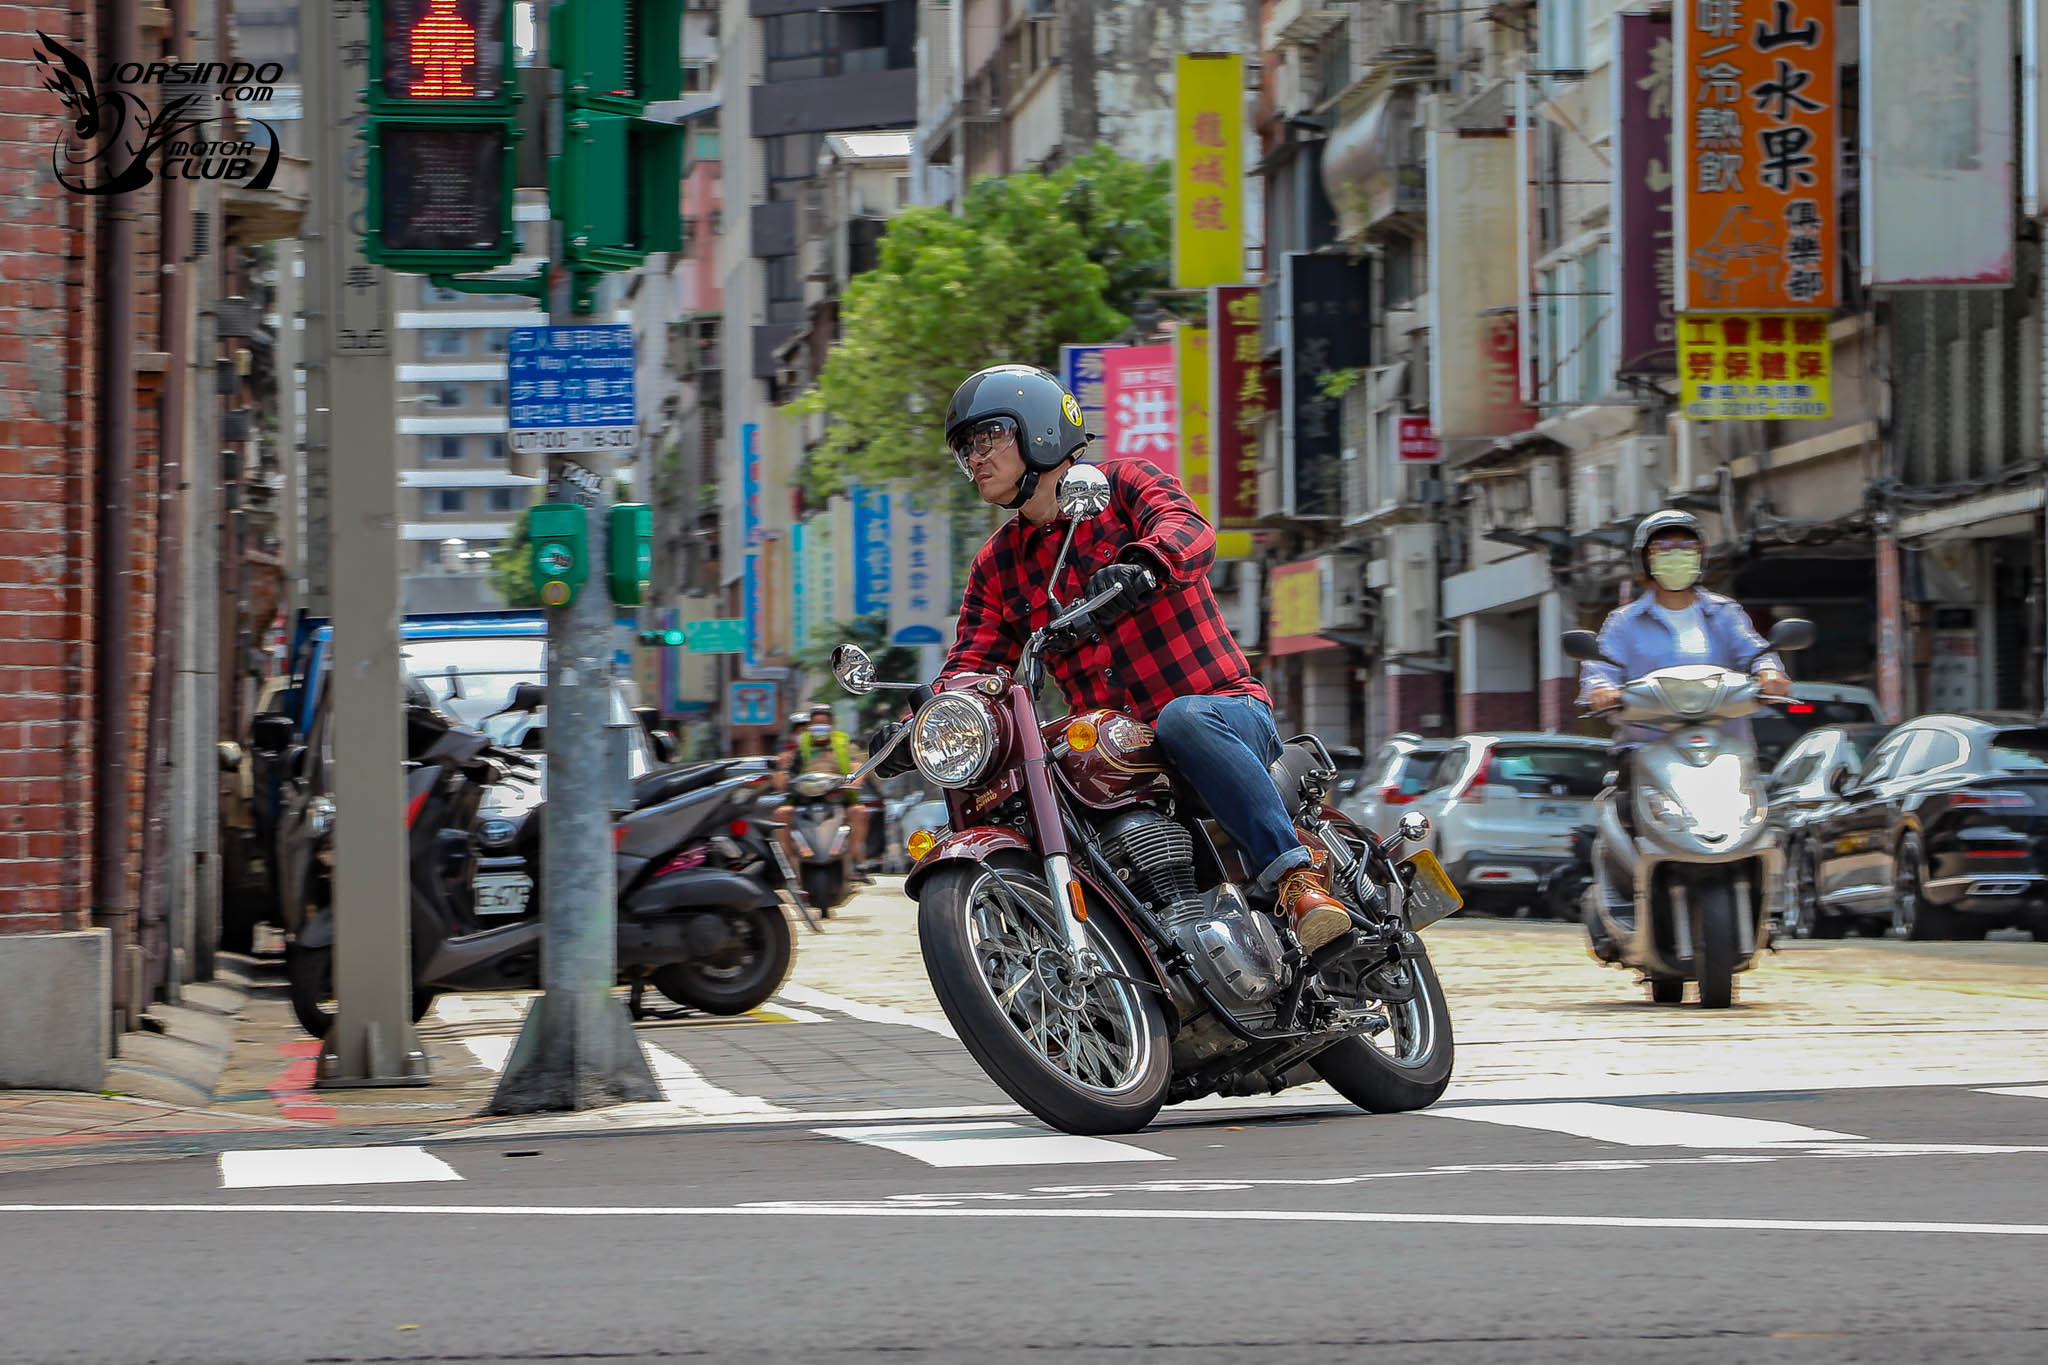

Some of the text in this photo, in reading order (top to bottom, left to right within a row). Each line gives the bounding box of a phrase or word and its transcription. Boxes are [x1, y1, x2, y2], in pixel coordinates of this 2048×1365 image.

[1748, 0, 1829, 194] 山水果
[1784, 200, 1825, 302] 俱樂部
